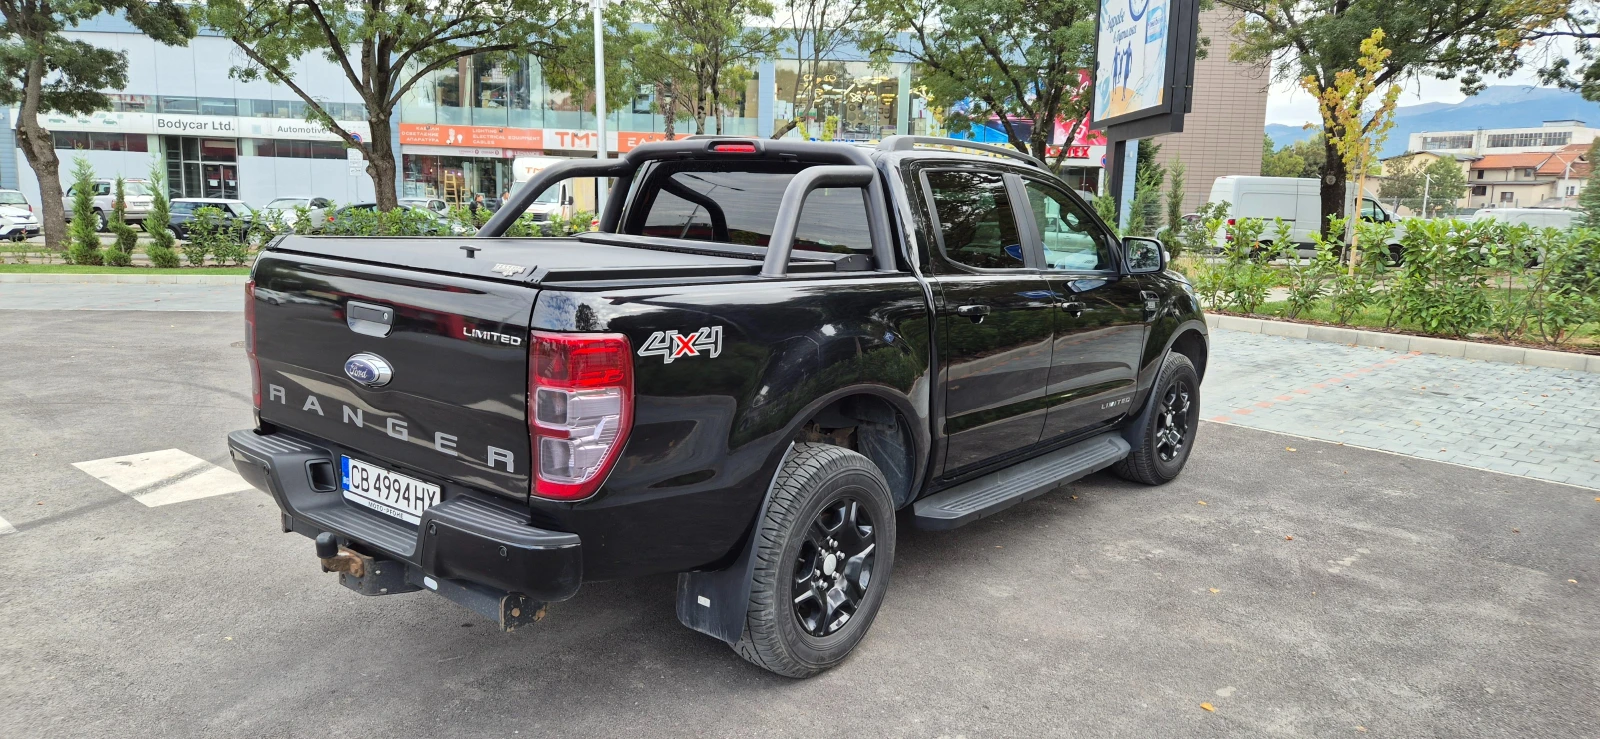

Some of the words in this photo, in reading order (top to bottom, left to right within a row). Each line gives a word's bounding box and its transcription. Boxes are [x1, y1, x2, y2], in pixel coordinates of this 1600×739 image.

[157, 118, 208, 131] Bodycar
[212, 121, 235, 131] Ltd.
[277, 125, 327, 134] Automotive
[462, 326, 522, 346] LIMITED
[349, 362, 369, 379] Ford
[1101, 396, 1131, 410] LIMITED
[269, 383, 514, 473] RANGER
[368, 501, 404, 520] MOTO-PFOHE
